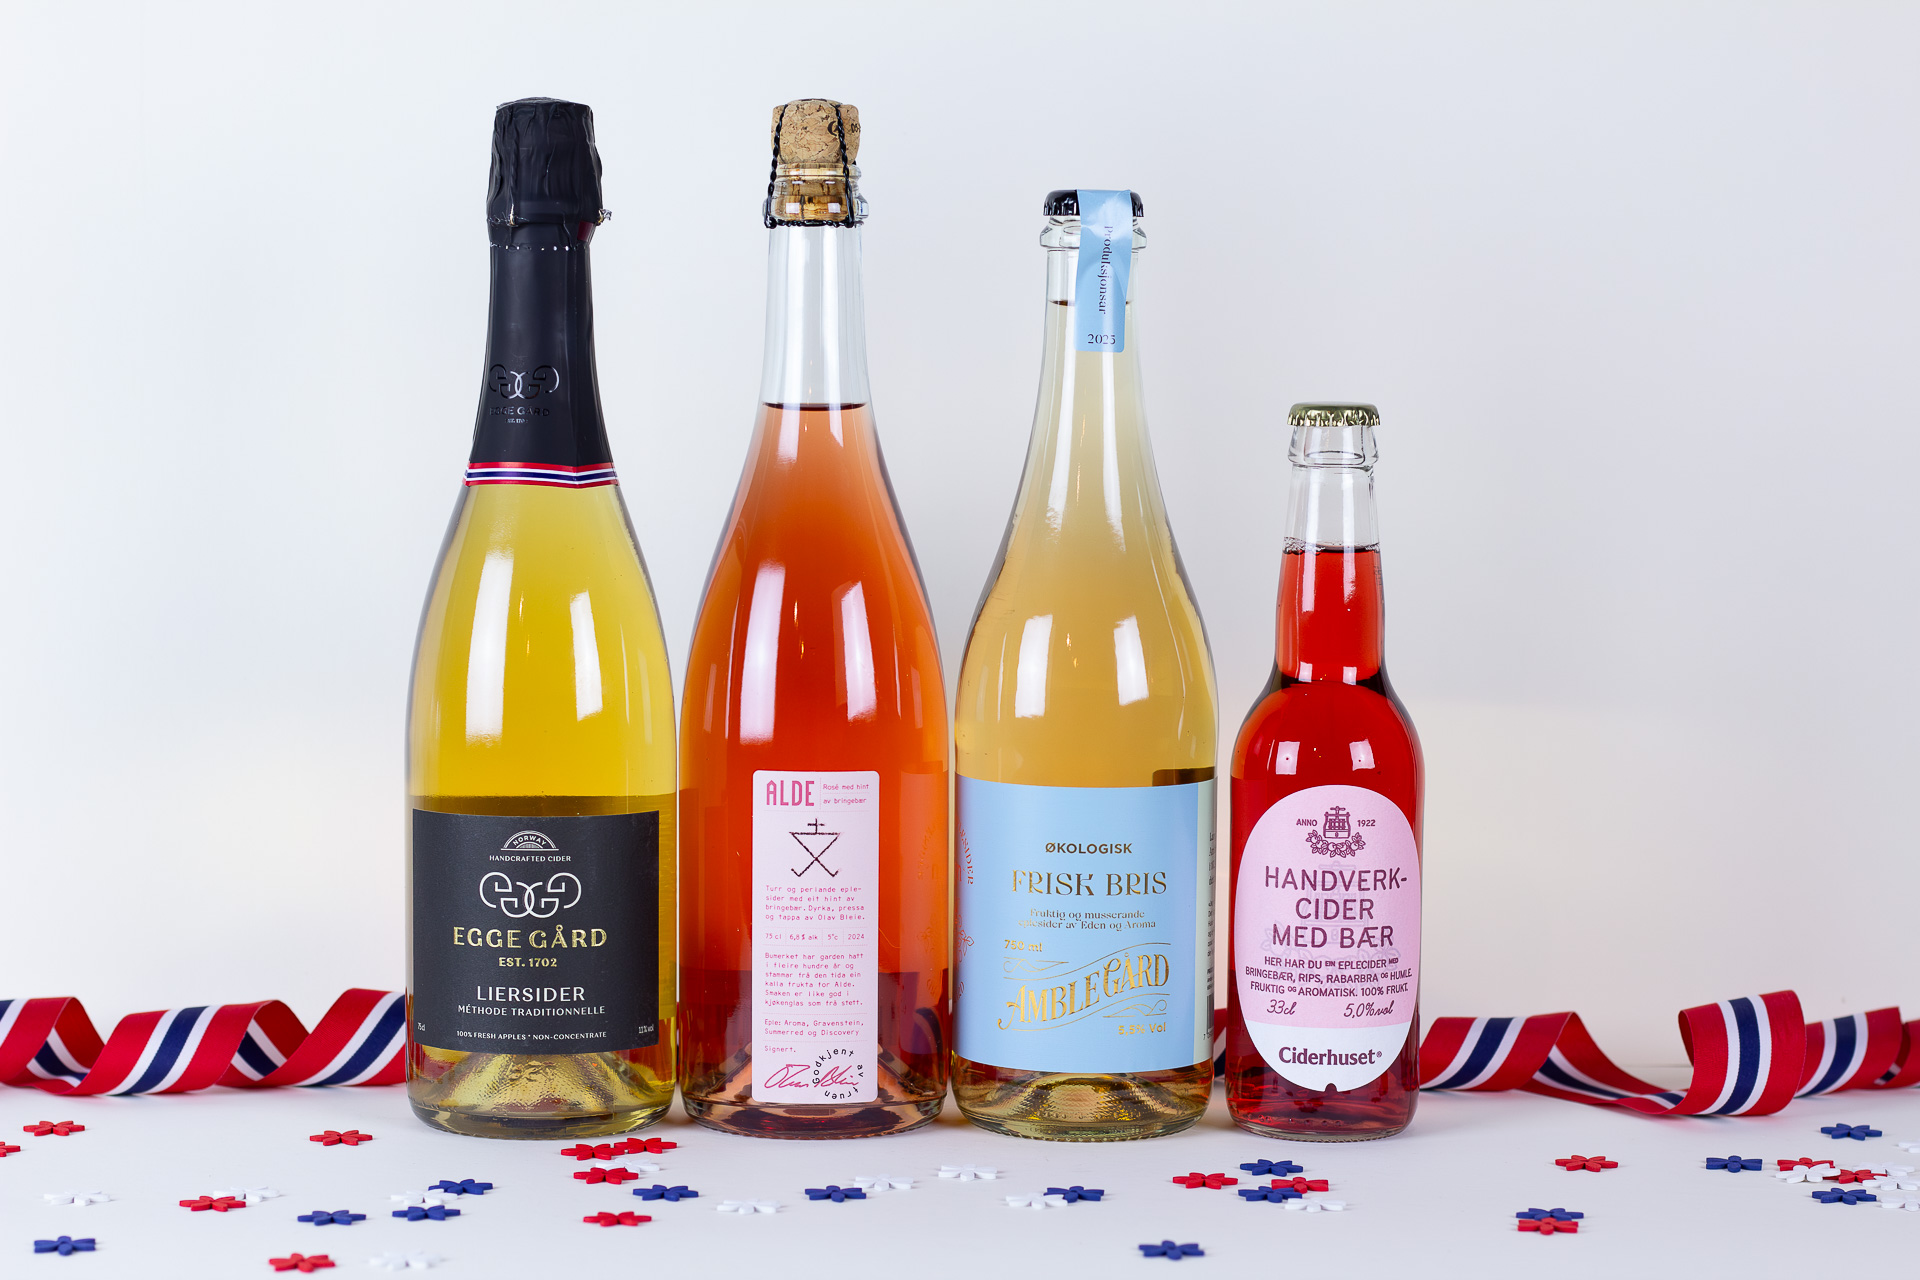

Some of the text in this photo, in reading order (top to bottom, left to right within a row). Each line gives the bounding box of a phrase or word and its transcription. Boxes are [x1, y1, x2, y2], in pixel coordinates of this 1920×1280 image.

[766, 780, 815, 806] ALDE
[1296, 818, 1318, 827] ANNO
[1357, 819, 1376, 827] 1922
[512, 835, 547, 846] NORWAY
[1045, 842, 1132, 854] ØKOLOGISK
[1012, 869, 1167, 896] FRISK BRIS
[1265, 865, 1407, 892] HANDVERK-
[1030, 908, 1145, 921] Fruktig og musserande
[1295, 897, 1374, 920] CIDER
[1018, 918, 1063, 929] eplesider
[1081, 921, 1106, 930] Eden
[1109, 923, 1122, 931] og
[1124, 921, 1156, 929] Aroma
[453, 924, 607, 949] EGGE GÅRD
[1272, 923, 1394, 949] MED BÆR
[1004, 939, 1043, 952] 750 ml
[498, 957, 557, 967] EST. 1702
[1264, 956, 1282, 967] HER
[1284, 958, 1305, 969] HAR
[1307, 960, 1322, 969] DU
[1338, 959, 1386, 970] EPLECIDER
[1245, 966, 1296, 983] BRINGEBÆR,
[1298, 973, 1323, 985] RIPS,
[1326, 974, 1379, 984] RABARBRA
[477, 986, 585, 1002] LIERSIDER
[1250, 981, 1285, 994] FRUKTIG
[1298, 986, 1358, 997] AROMATISK.
[1361, 986, 1384, 997] 100%
[458, 1004, 605, 1016] MÉTHODE TRADITIONNELLE
[1266, 999, 1297, 1015] 33cl
[764, 1019, 781, 1027] Eple:
[1118, 1022, 1166, 1037] 5,5% Vol
[457, 1030, 472, 1038] 100%
[533, 1031, 607, 1040] NON-CONCENTRATE
[764, 1028, 804, 1036] Summerred
[764, 1045, 796, 1053] Signert.
[812, 1049, 863, 1099] Godkjent av fruen
